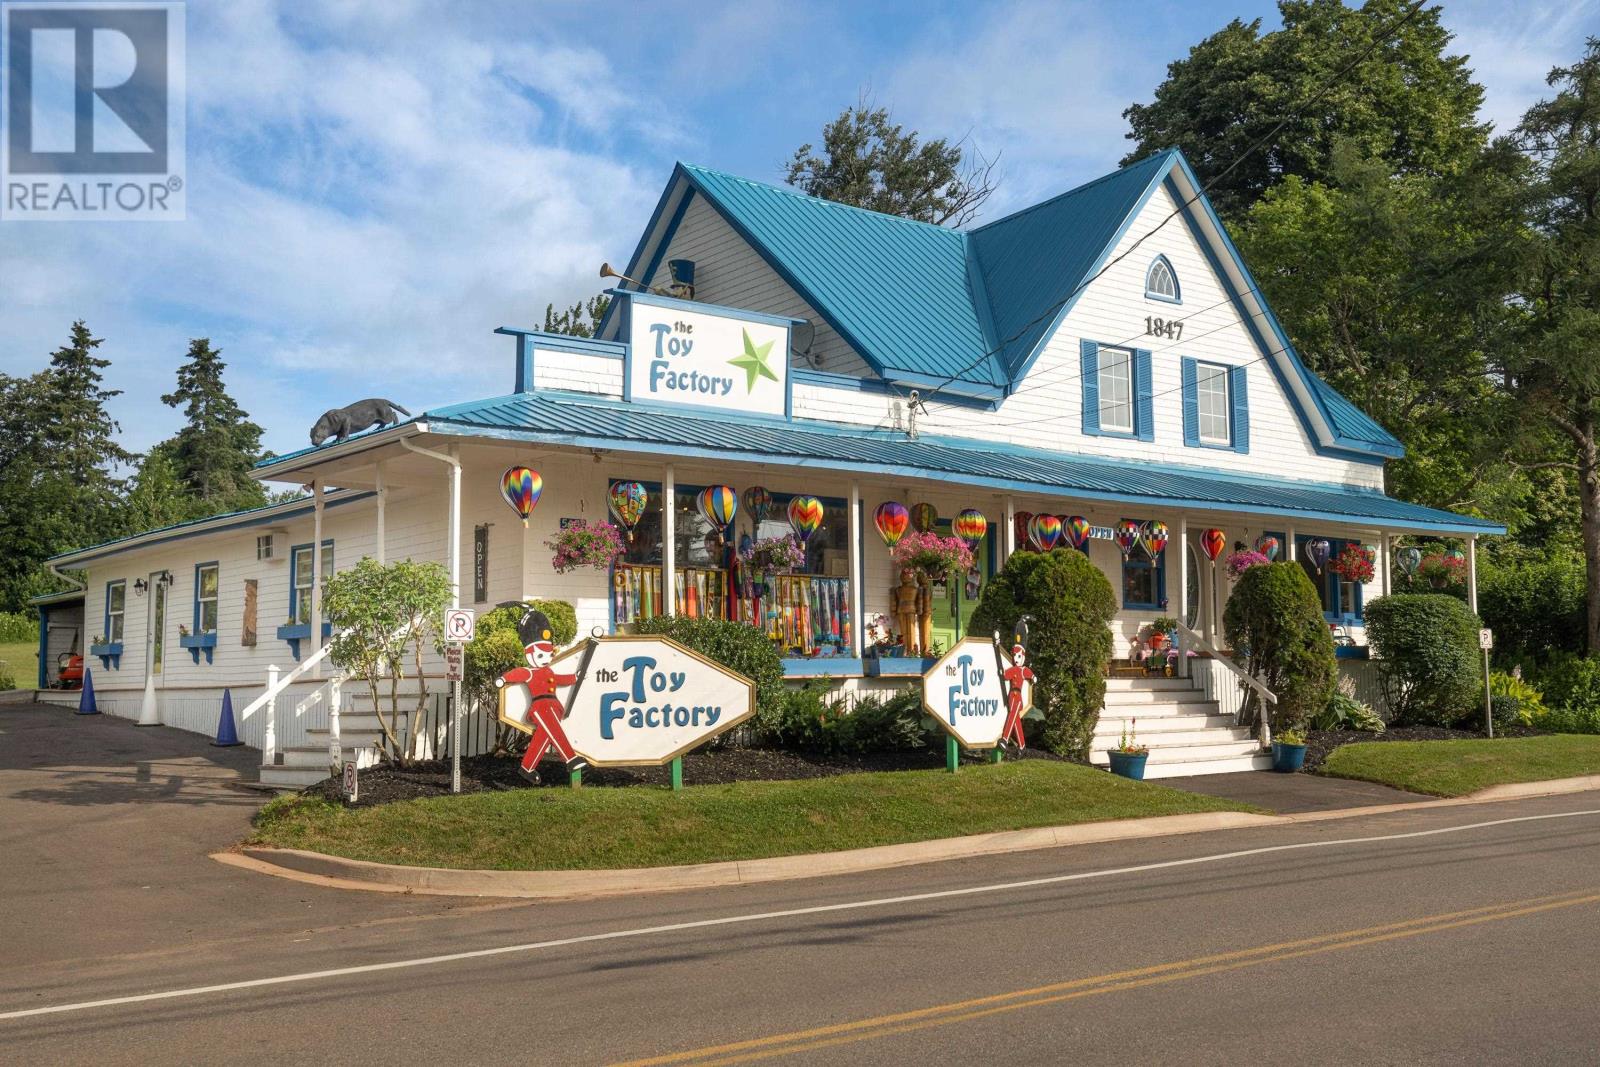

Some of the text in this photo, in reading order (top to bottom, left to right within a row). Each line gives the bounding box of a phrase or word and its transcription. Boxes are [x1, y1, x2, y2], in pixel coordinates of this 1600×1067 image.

[650, 323, 693, 358] Toy
[674, 321, 693, 334] the
[1144, 316, 1184, 341] 1847
[650, 360, 733, 396] Factory
[1090, 527, 1112, 539] OPEN
[596, 656, 686, 703] the Toy
[946, 654, 984, 695] the Toy
[600, 692, 721, 740] Factory
[949, 685, 998, 726] Factory
